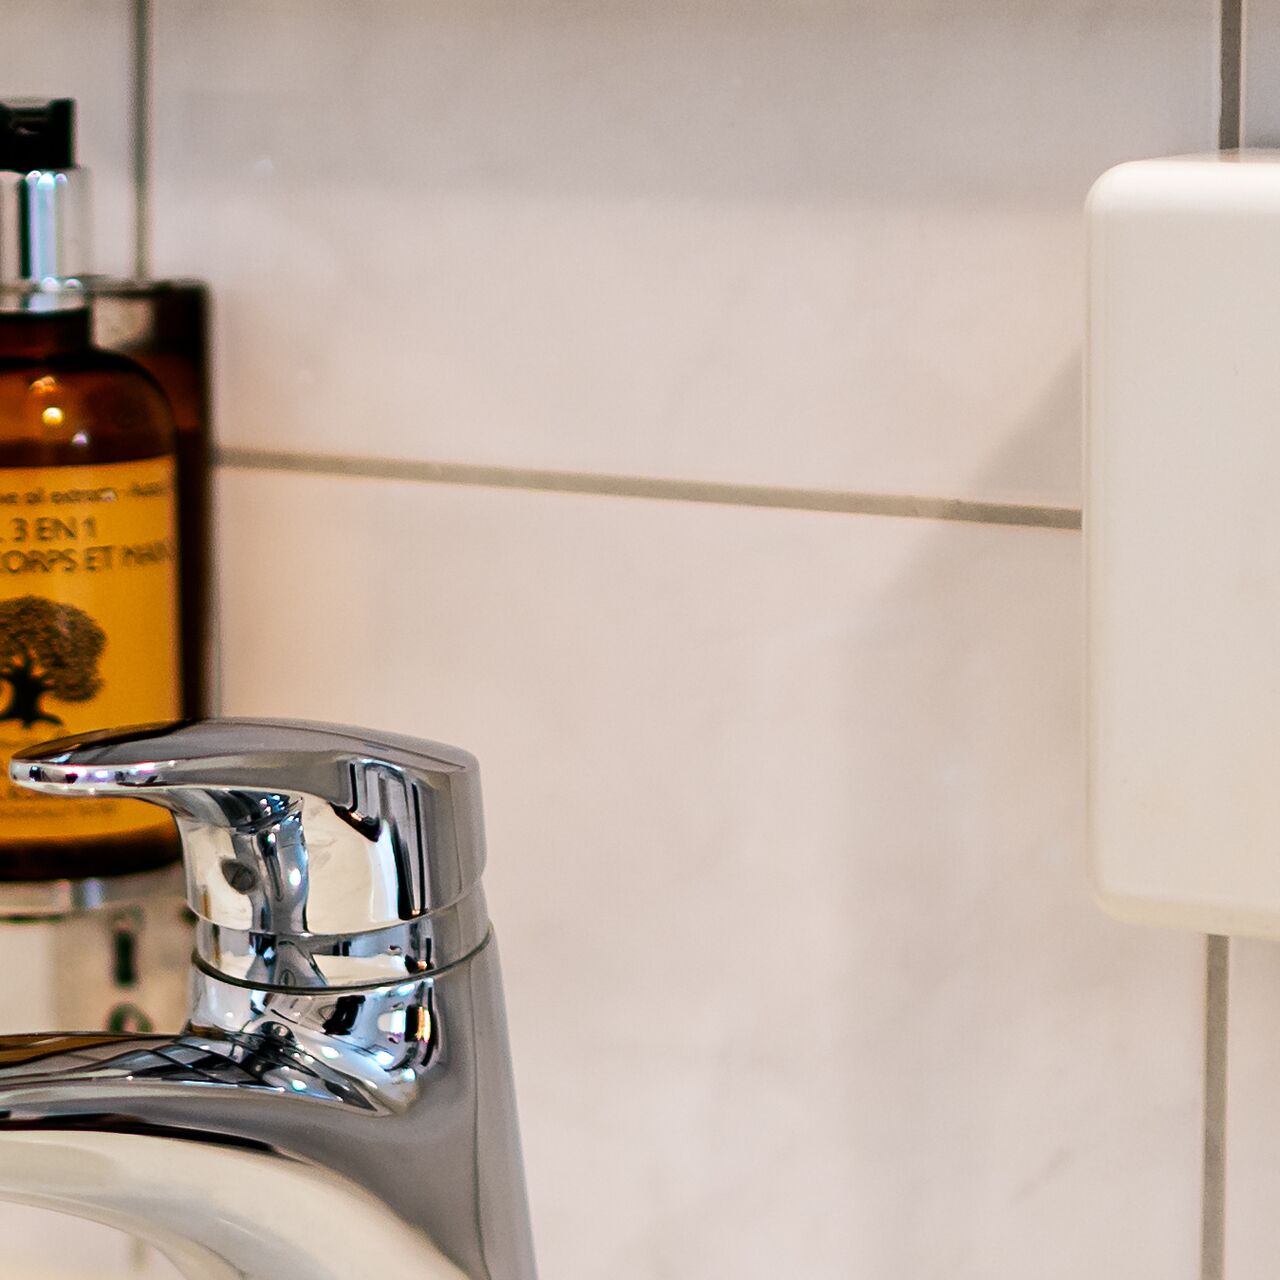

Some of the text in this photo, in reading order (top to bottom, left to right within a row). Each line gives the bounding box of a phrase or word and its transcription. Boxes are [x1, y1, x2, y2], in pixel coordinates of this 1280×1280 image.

[10, 516, 29, 542] 3
[34, 516, 77, 542] EN
[82, 515, 98, 540] 1
[85, 545, 115, 574] ET
